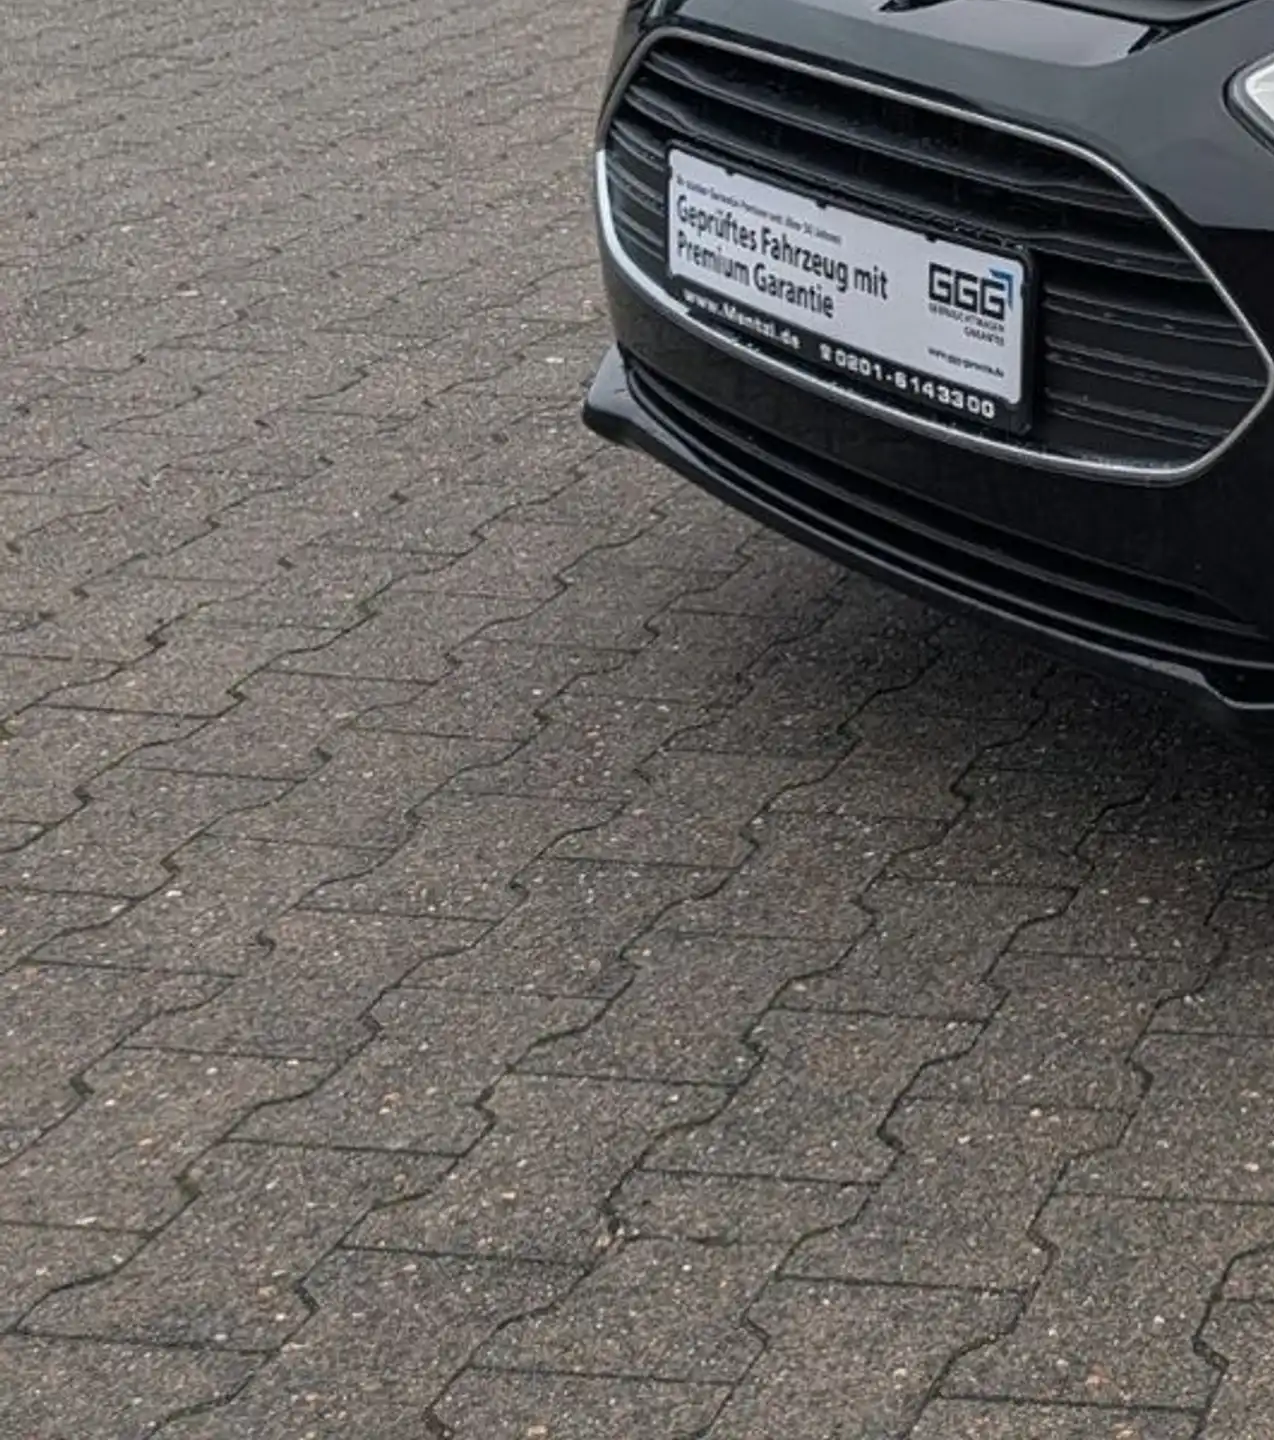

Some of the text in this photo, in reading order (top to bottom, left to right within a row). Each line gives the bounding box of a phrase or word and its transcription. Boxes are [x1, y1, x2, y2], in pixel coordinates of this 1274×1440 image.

[676, 194, 757, 252] Geprüftes
[760, 226, 849, 293] Fahrzeug
[853, 265, 888, 300] mit
[676, 229, 835, 319] Premium Garantie
[928, 262, 1005, 322] GGG
